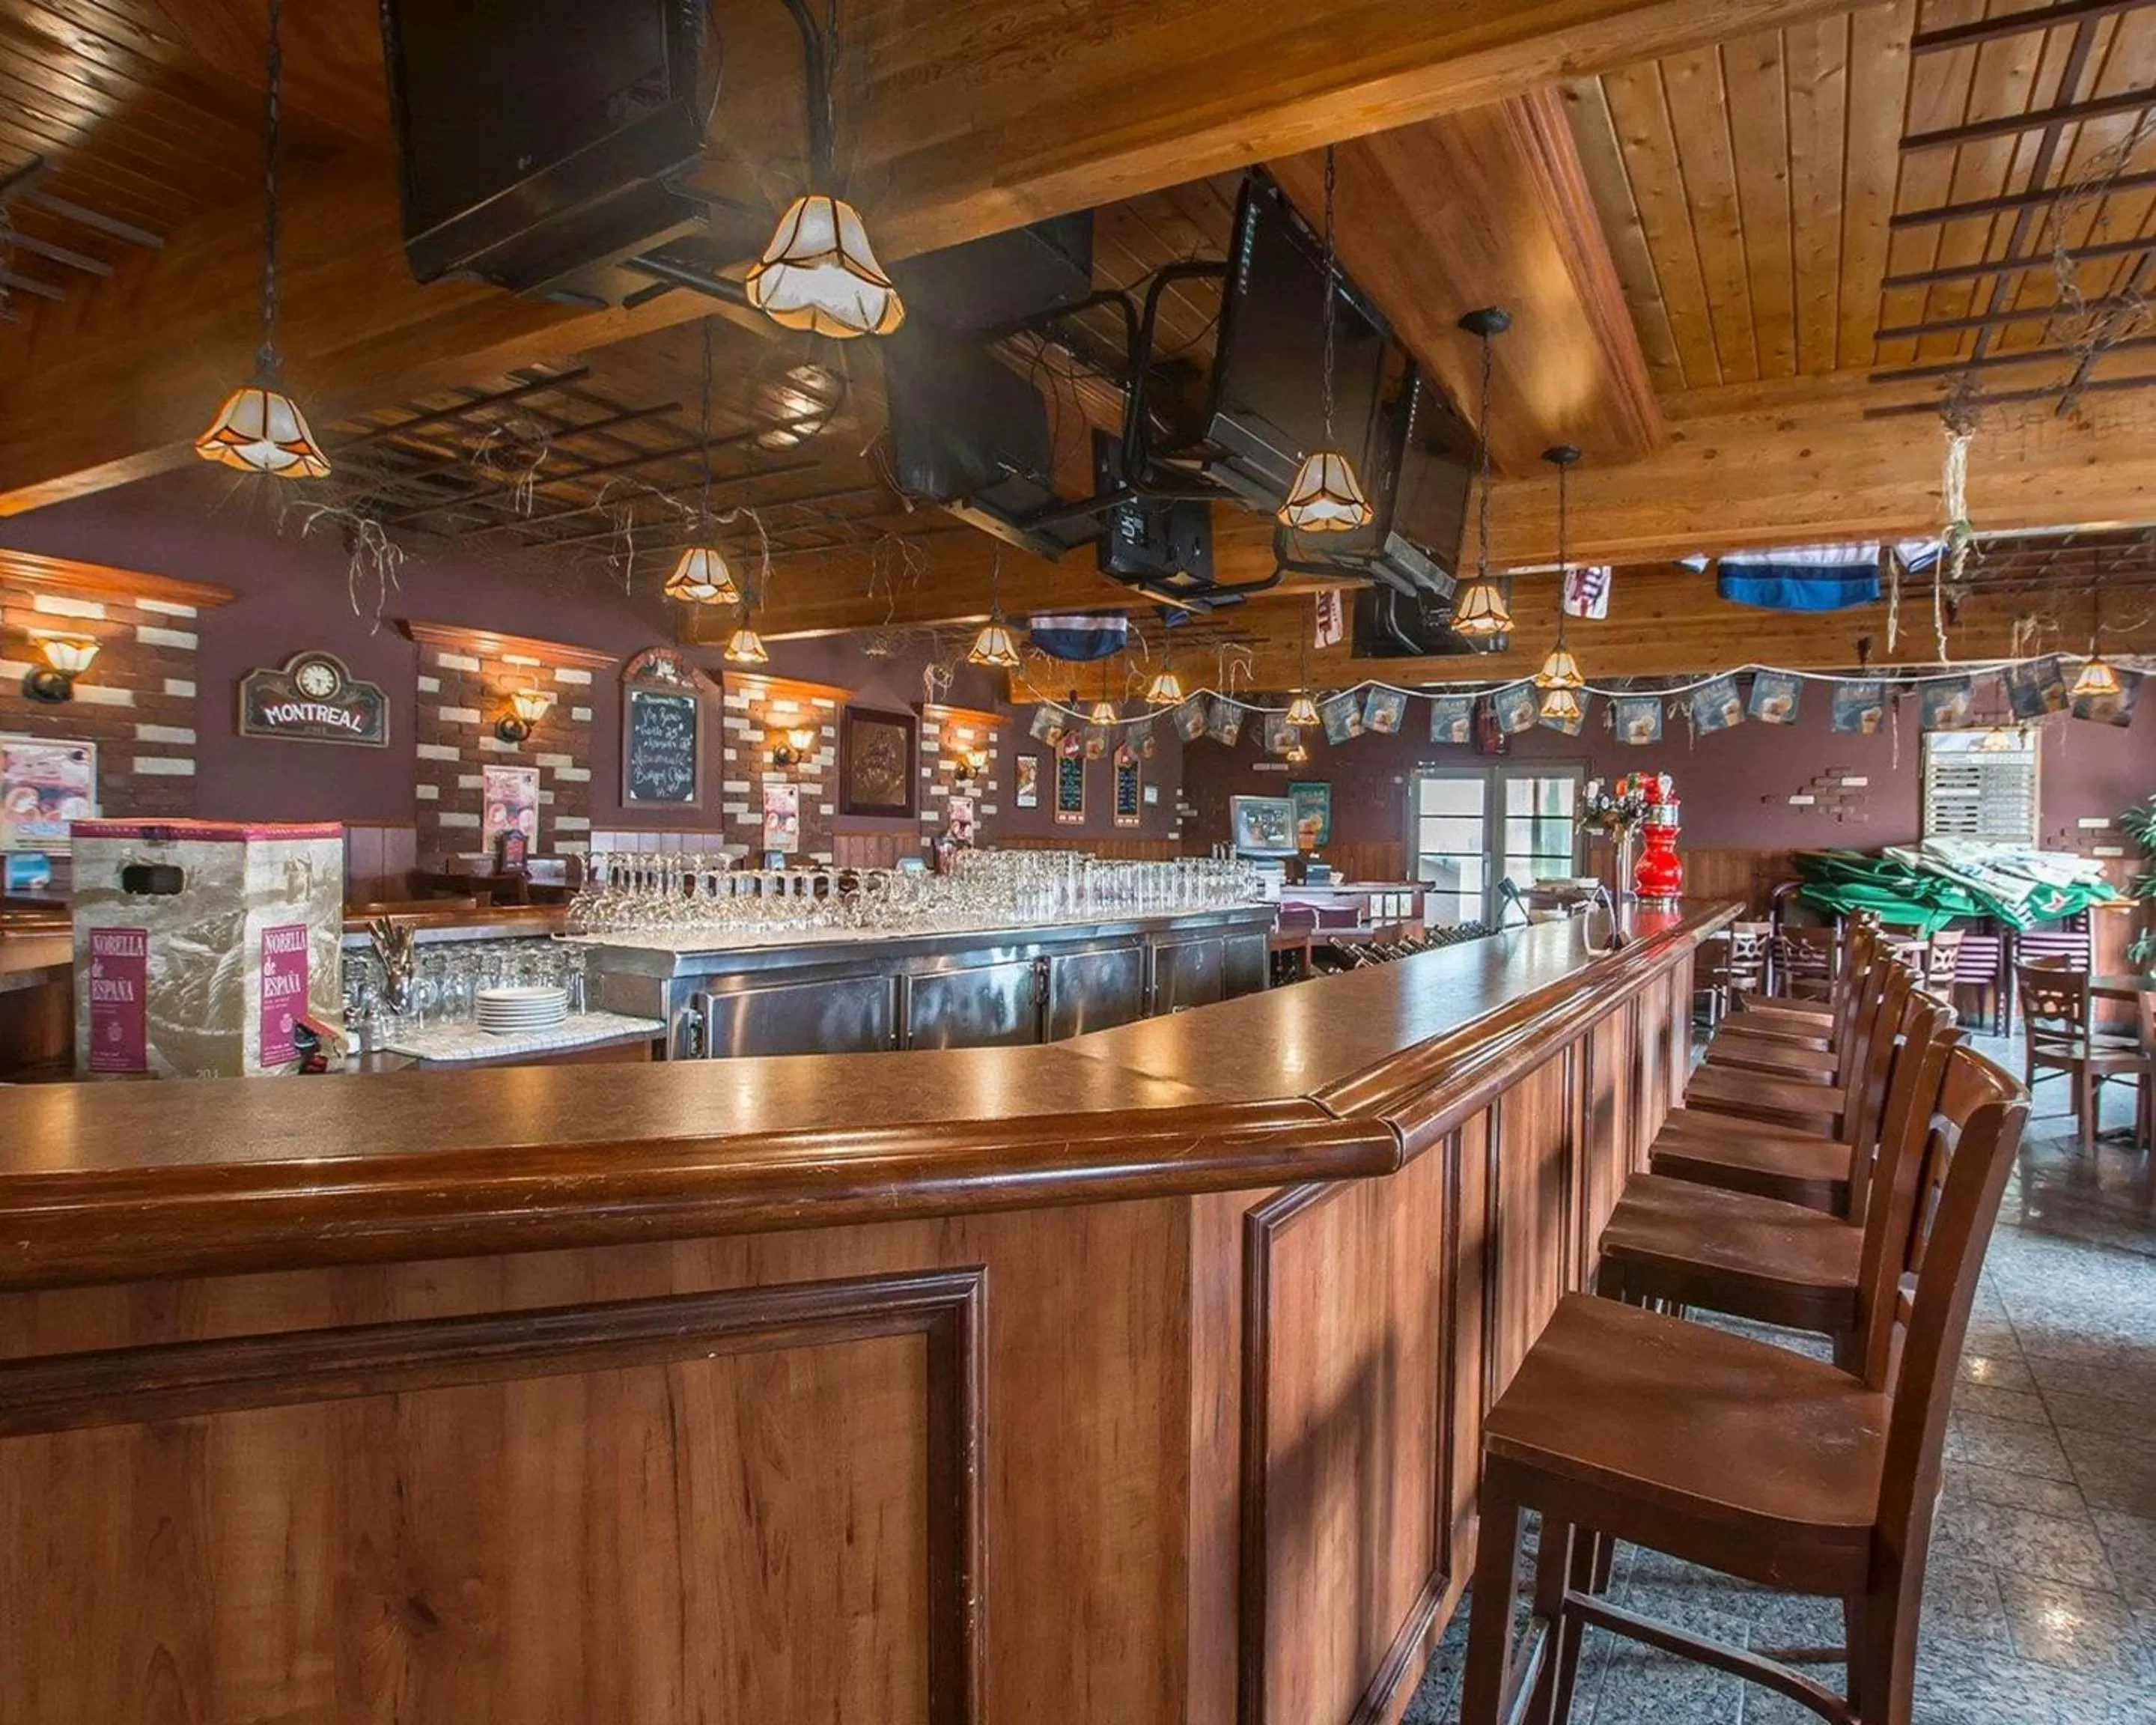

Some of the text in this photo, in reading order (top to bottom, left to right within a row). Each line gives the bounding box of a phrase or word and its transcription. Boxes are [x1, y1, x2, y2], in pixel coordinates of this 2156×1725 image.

[264, 702, 363, 734] MONTREAL
[92, 934, 144, 957] NOBELLA
[264, 931, 306, 956] NOBELLA
[92, 957, 104, 978] de
[264, 955, 277, 976] de
[91, 976, 134, 1002] ESPAÑA
[264, 970, 302, 998] ESPAÑA
